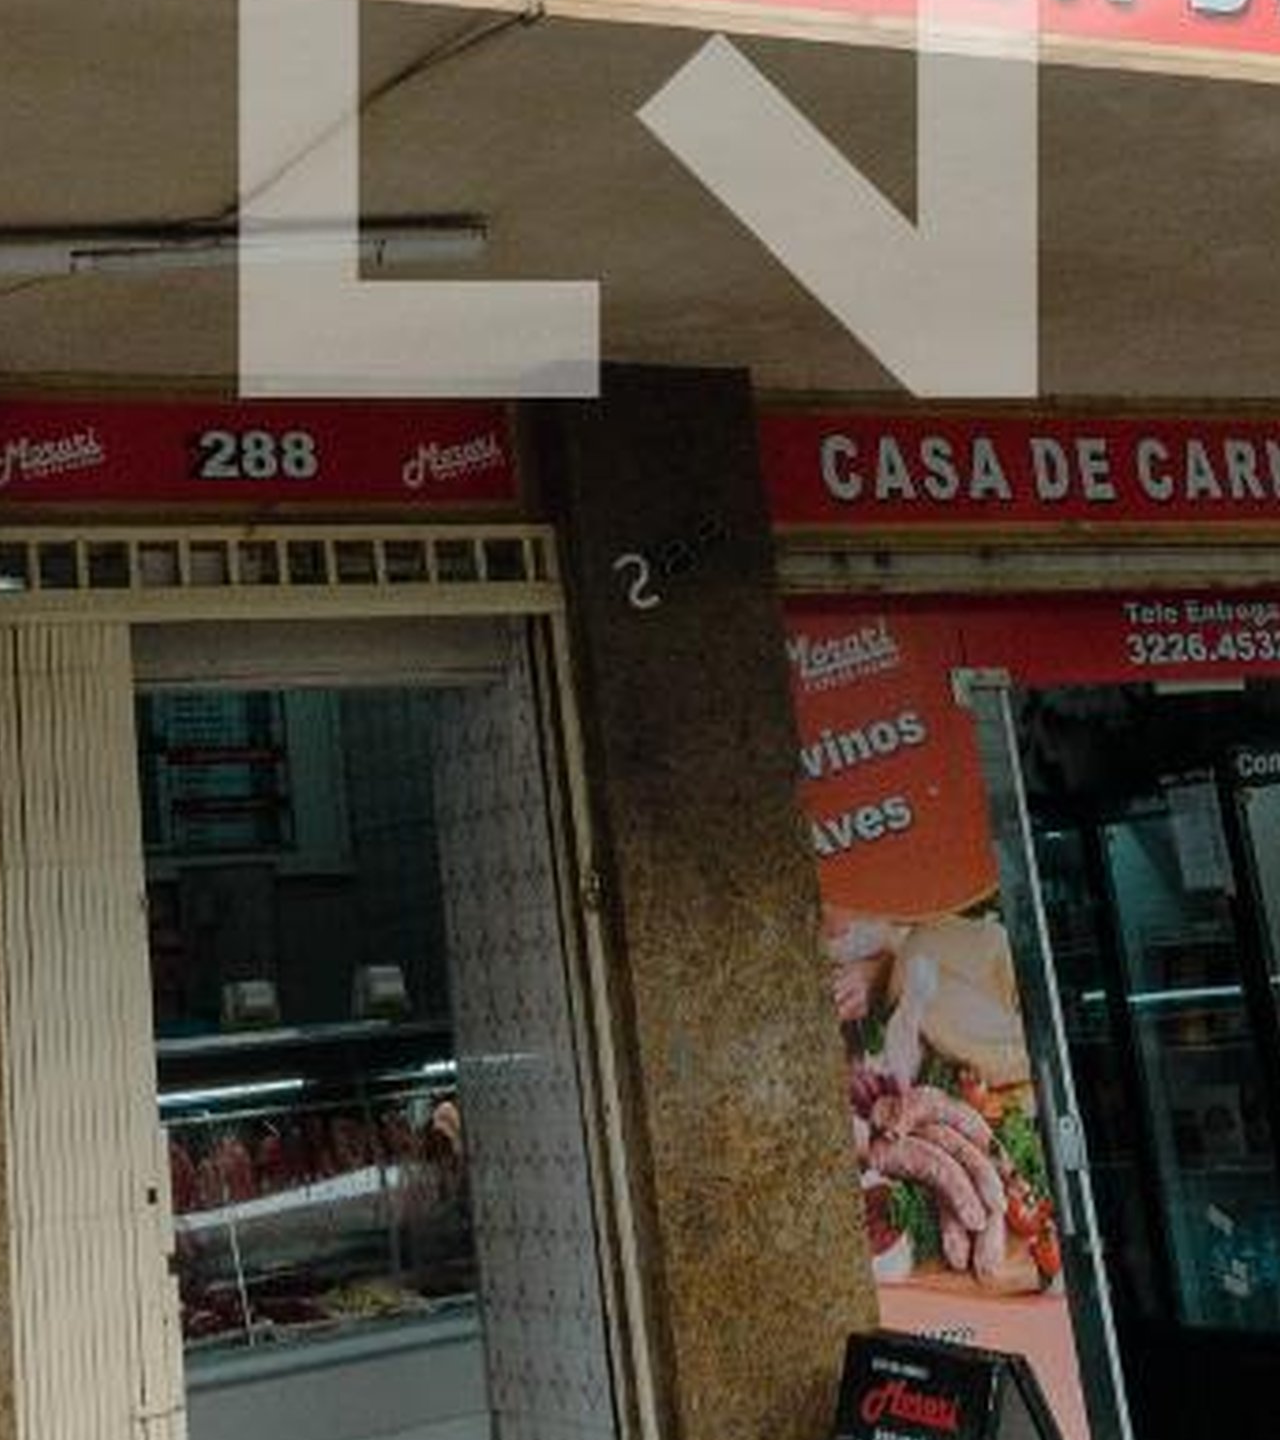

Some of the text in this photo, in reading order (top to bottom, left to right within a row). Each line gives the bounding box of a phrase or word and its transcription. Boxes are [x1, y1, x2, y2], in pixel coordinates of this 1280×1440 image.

[199, 430, 318, 479] 288
[821, 434, 1012, 501] CASA
[1030, 438, 1117, 501] DE
[1125, 602, 1179, 623] Tele
